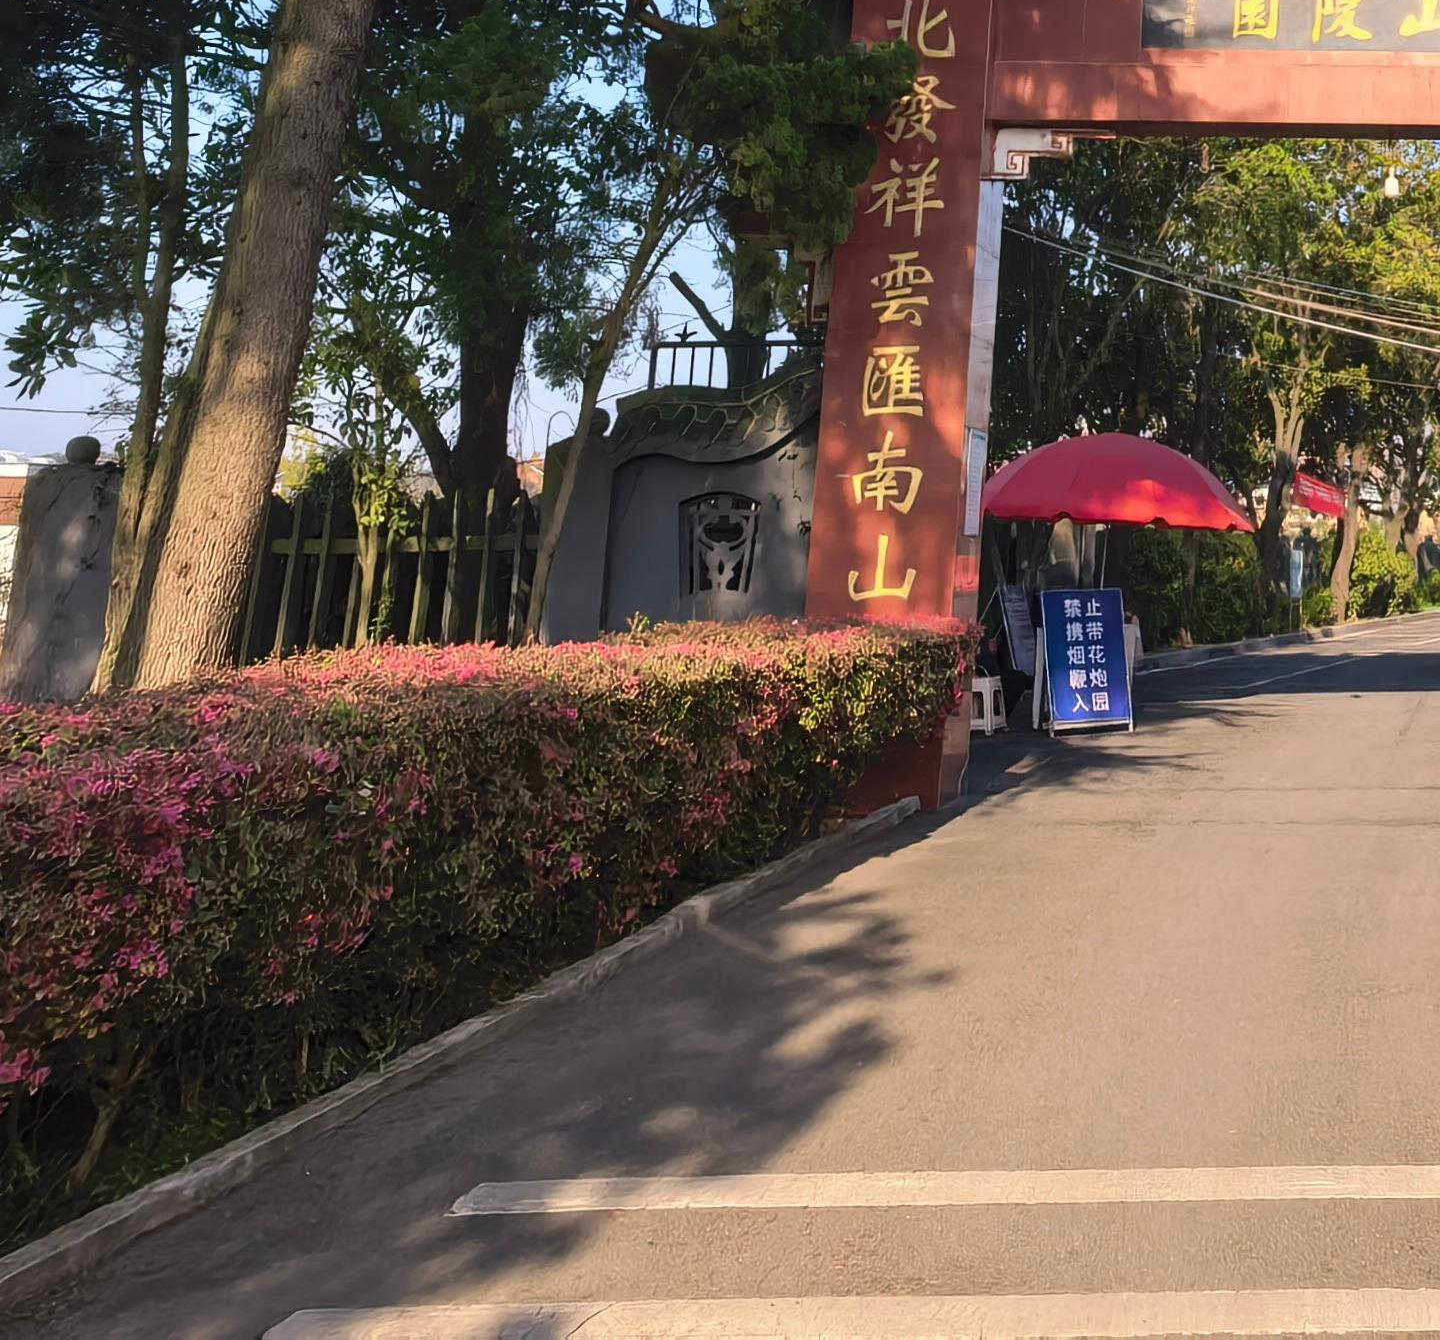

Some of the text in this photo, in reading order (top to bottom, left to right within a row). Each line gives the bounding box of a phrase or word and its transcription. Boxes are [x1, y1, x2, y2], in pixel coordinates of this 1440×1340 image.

[1063, 598, 1103, 619] 禁止
[1065, 621, 1104, 642] 携带
[1066, 644, 1107, 666] 烟花
[1069, 667, 1109, 690] 鞭炮
[1072, 691, 1110, 713] 入园
